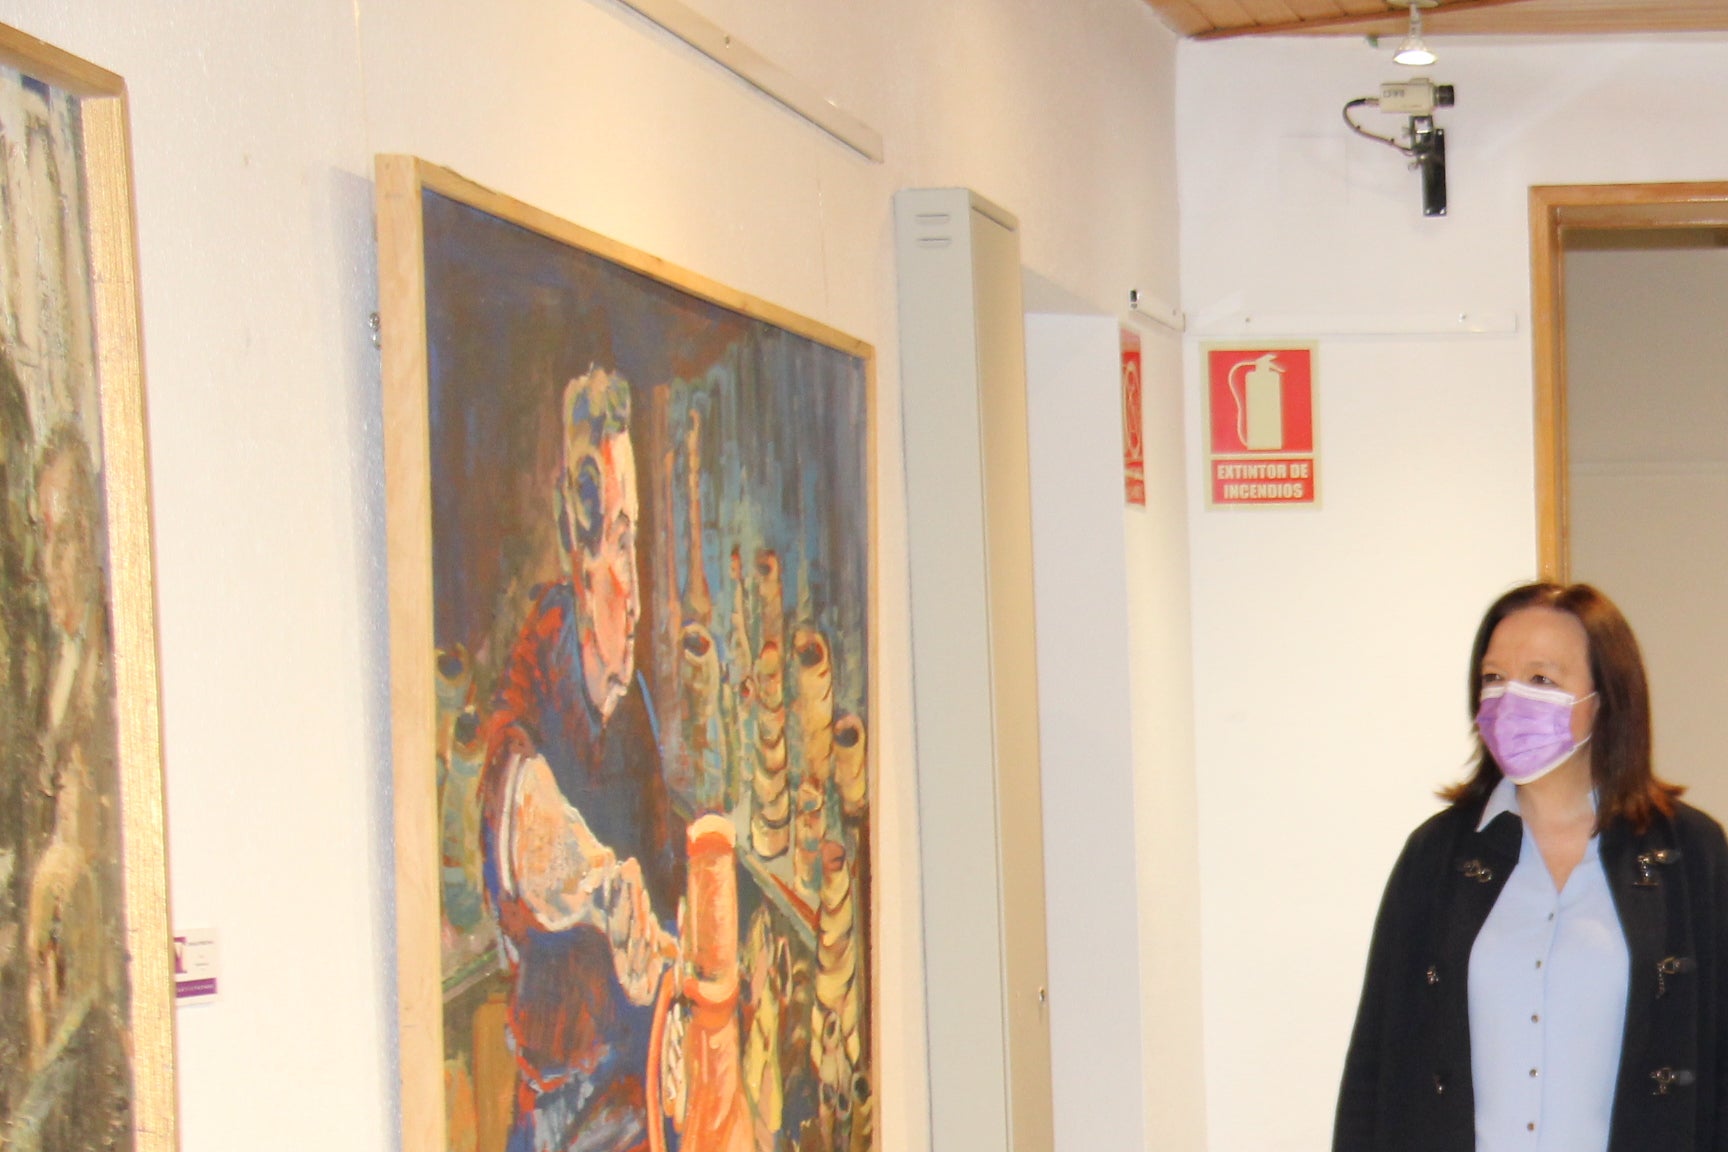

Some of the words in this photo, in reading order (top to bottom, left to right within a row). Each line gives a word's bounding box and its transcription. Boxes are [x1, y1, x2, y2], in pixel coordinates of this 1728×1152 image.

[1217, 464, 1286, 480] EXTINTOR
[1290, 463, 1309, 479] DE
[1223, 483, 1304, 499] INCENDIOS
